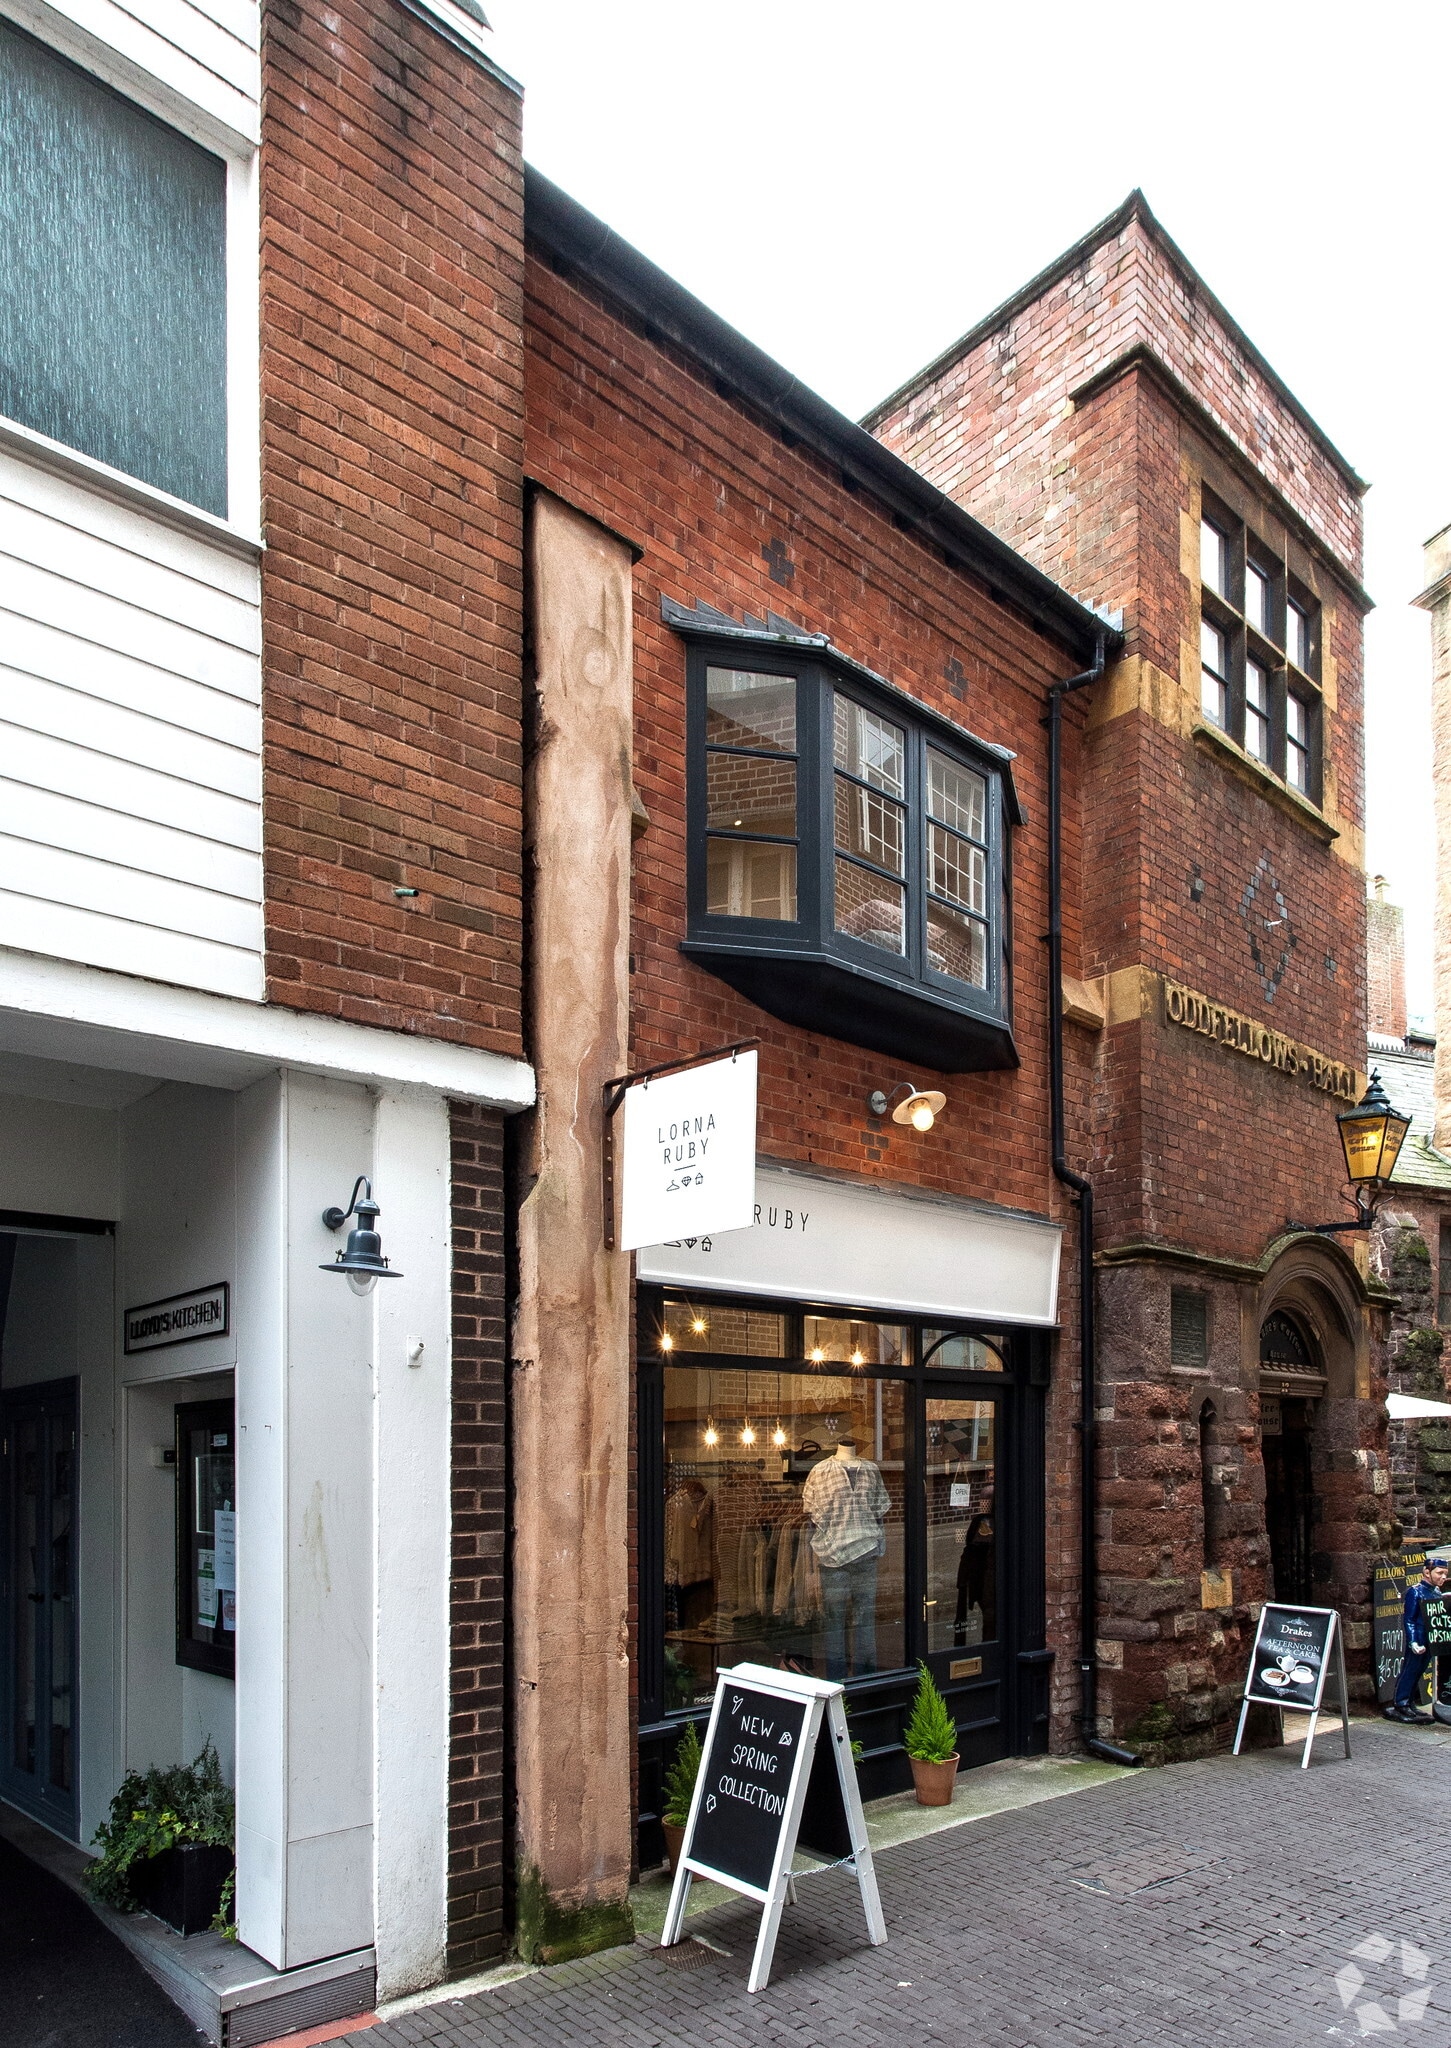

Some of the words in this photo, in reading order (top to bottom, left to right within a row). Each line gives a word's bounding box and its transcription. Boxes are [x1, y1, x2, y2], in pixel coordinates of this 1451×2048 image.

[1168, 990, 1299, 1076] ODDFELLOWS
[1308, 1054, 1357, 1103] HALL
[658, 1113, 716, 1144] LORNA
[663, 1137, 709, 1165] RUBY
[753, 1203, 809, 1232] RUBY
[130, 1312, 171, 1340] LLOYD'S
[172, 1299, 220, 1330] KITCHEN
[1375, 1566, 1406, 1579] FELLOWS
[1426, 1600, 1447, 1617] HAIR
[1280, 1624, 1313, 1638] Drakes
[1430, 1614, 1451, 1628] CUTS
[1266, 1638, 1320, 1653] AFTERNOON
[1381, 1629, 1404, 1652] FROM
[1428, 1628, 1451, 1644] UPSTA
[1267, 1644, 1283, 1653] TEA
[1292, 1650, 1317, 1659] CAKE
[740, 1715, 775, 1738] NEW
[731, 1744, 778, 1774] SPRING
[718, 1775, 785, 1816] COLLECTION
